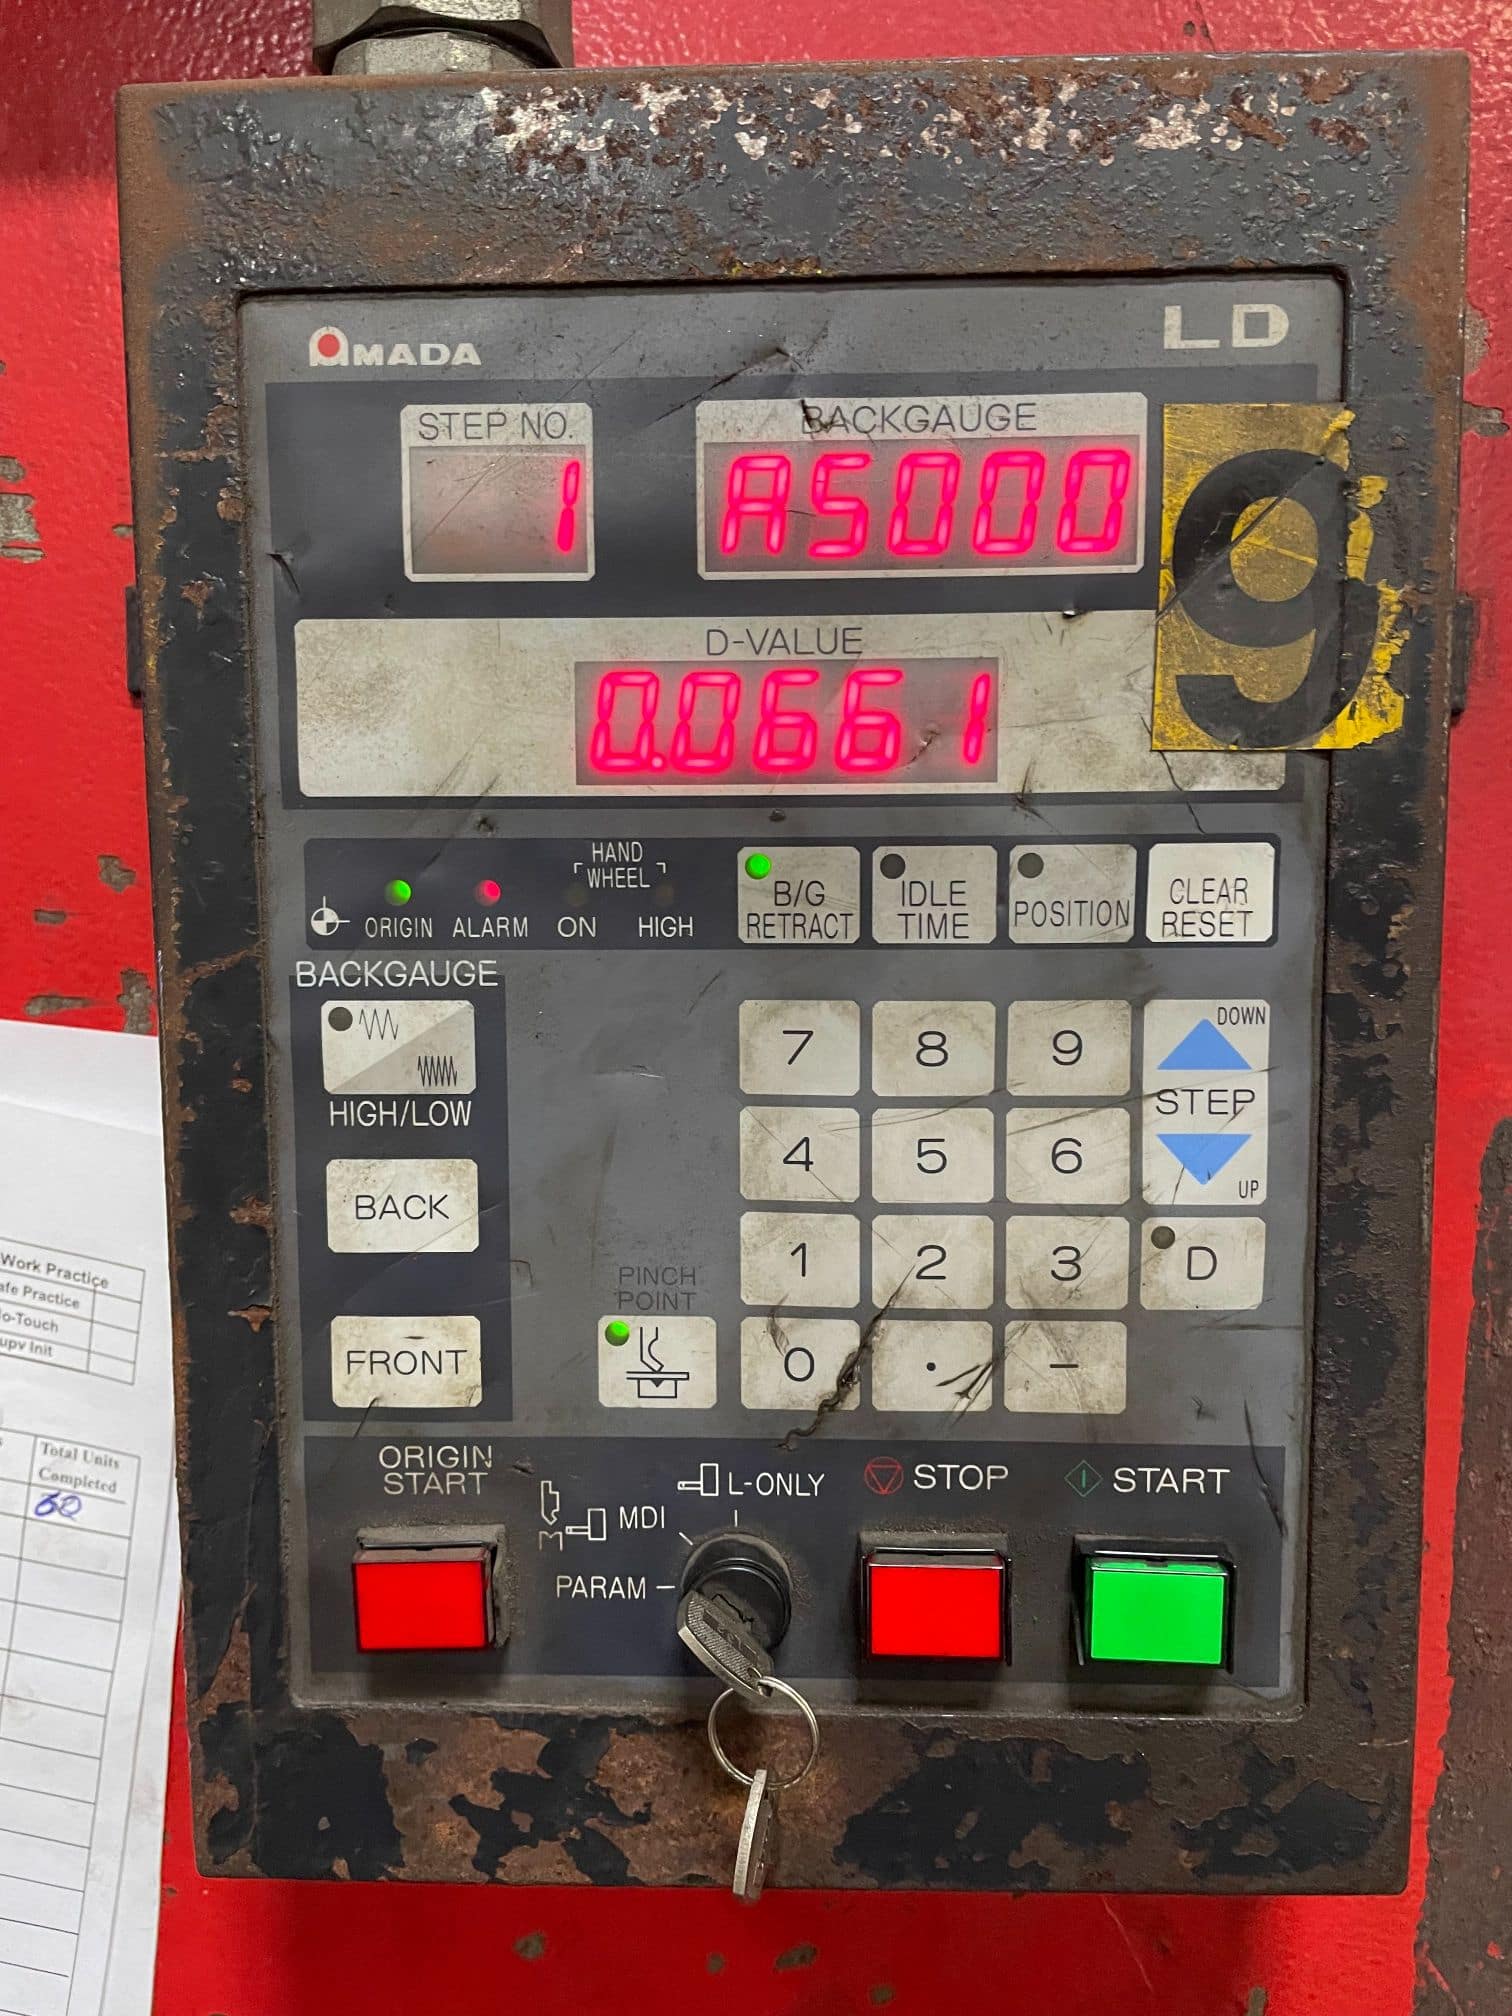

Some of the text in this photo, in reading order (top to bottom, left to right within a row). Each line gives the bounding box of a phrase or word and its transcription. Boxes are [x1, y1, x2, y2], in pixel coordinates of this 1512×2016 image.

[1163, 303, 1290, 350] LD
[309, 326, 482, 367] AMADA
[418, 411, 574, 441] STEP NO.
[801, 402, 1038, 435] BACKGAUGE
[556, 459, 581, 553] 1
[1172, 448, 1379, 749] 9
[706, 626, 864, 656] D-VALUE
[591, 841, 644, 863] HAND
[586, 867, 651, 889] WHEEL
[1168, 877, 1249, 906] CLEAR
[773, 880, 826, 907] B/G
[900, 880, 967, 908] IDLE
[364, 917, 433, 939] ORIGIN
[451, 917, 529, 939] ALARM
[557, 916, 597, 938] ON
[638, 916, 694, 938] HIGH
[746, 912, 855, 941] RETRACT
[897, 912, 970, 941] TIME
[1014, 899, 1131, 929] POSITION
[1161, 910, 1254, 938] RESET
[295, 959, 499, 988] BACKGAUGE
[1217, 1006, 1266, 1026] DOWN
[781, 1029, 814, 1066] 7
[914, 1030, 949, 1067] 8
[1051, 1029, 1084, 1067] 9
[329, 1100, 472, 1128] HIGH/LOW
[1155, 1088, 1256, 1117] STEP
[782, 1136, 815, 1172] 4
[916, 1138, 948, 1175] 5
[1050, 1137, 1083, 1175] 6
[1238, 1179, 1260, 1200] UP
[354, 1193, 450, 1221] BACK
[0, 1252, 110, 1290] Work Practice
[789, 1242, 807, 1278] 1
[915, 1244, 947, 1281] 2
[1050, 1245, 1083, 1282] 3
[1186, 1246, 1218, 1281] D
[617, 1265, 697, 1287] PINCH
[23, 1285, 81, 1310] Practice
[616, 1290, 698, 1312] POINT
[0, 1311, 59, 1334] o-Touch
[30, 1340, 53, 1358] Init
[346, 1349, 468, 1377] FRONT
[783, 1346, 815, 1383] 0
[40, 1441, 121, 1470] Total Units
[378, 1444, 494, 1470] ORIGIN
[38, 1466, 118, 1495] Completed
[382, 1472, 488, 1497] START
[727, 1472, 825, 1498] L-ONLY
[912, 1463, 1010, 1492] STOP
[1112, 1467, 1232, 1495] START
[618, 1505, 665, 1530] MDI
[555, 1575, 647, 1600] PARAM
